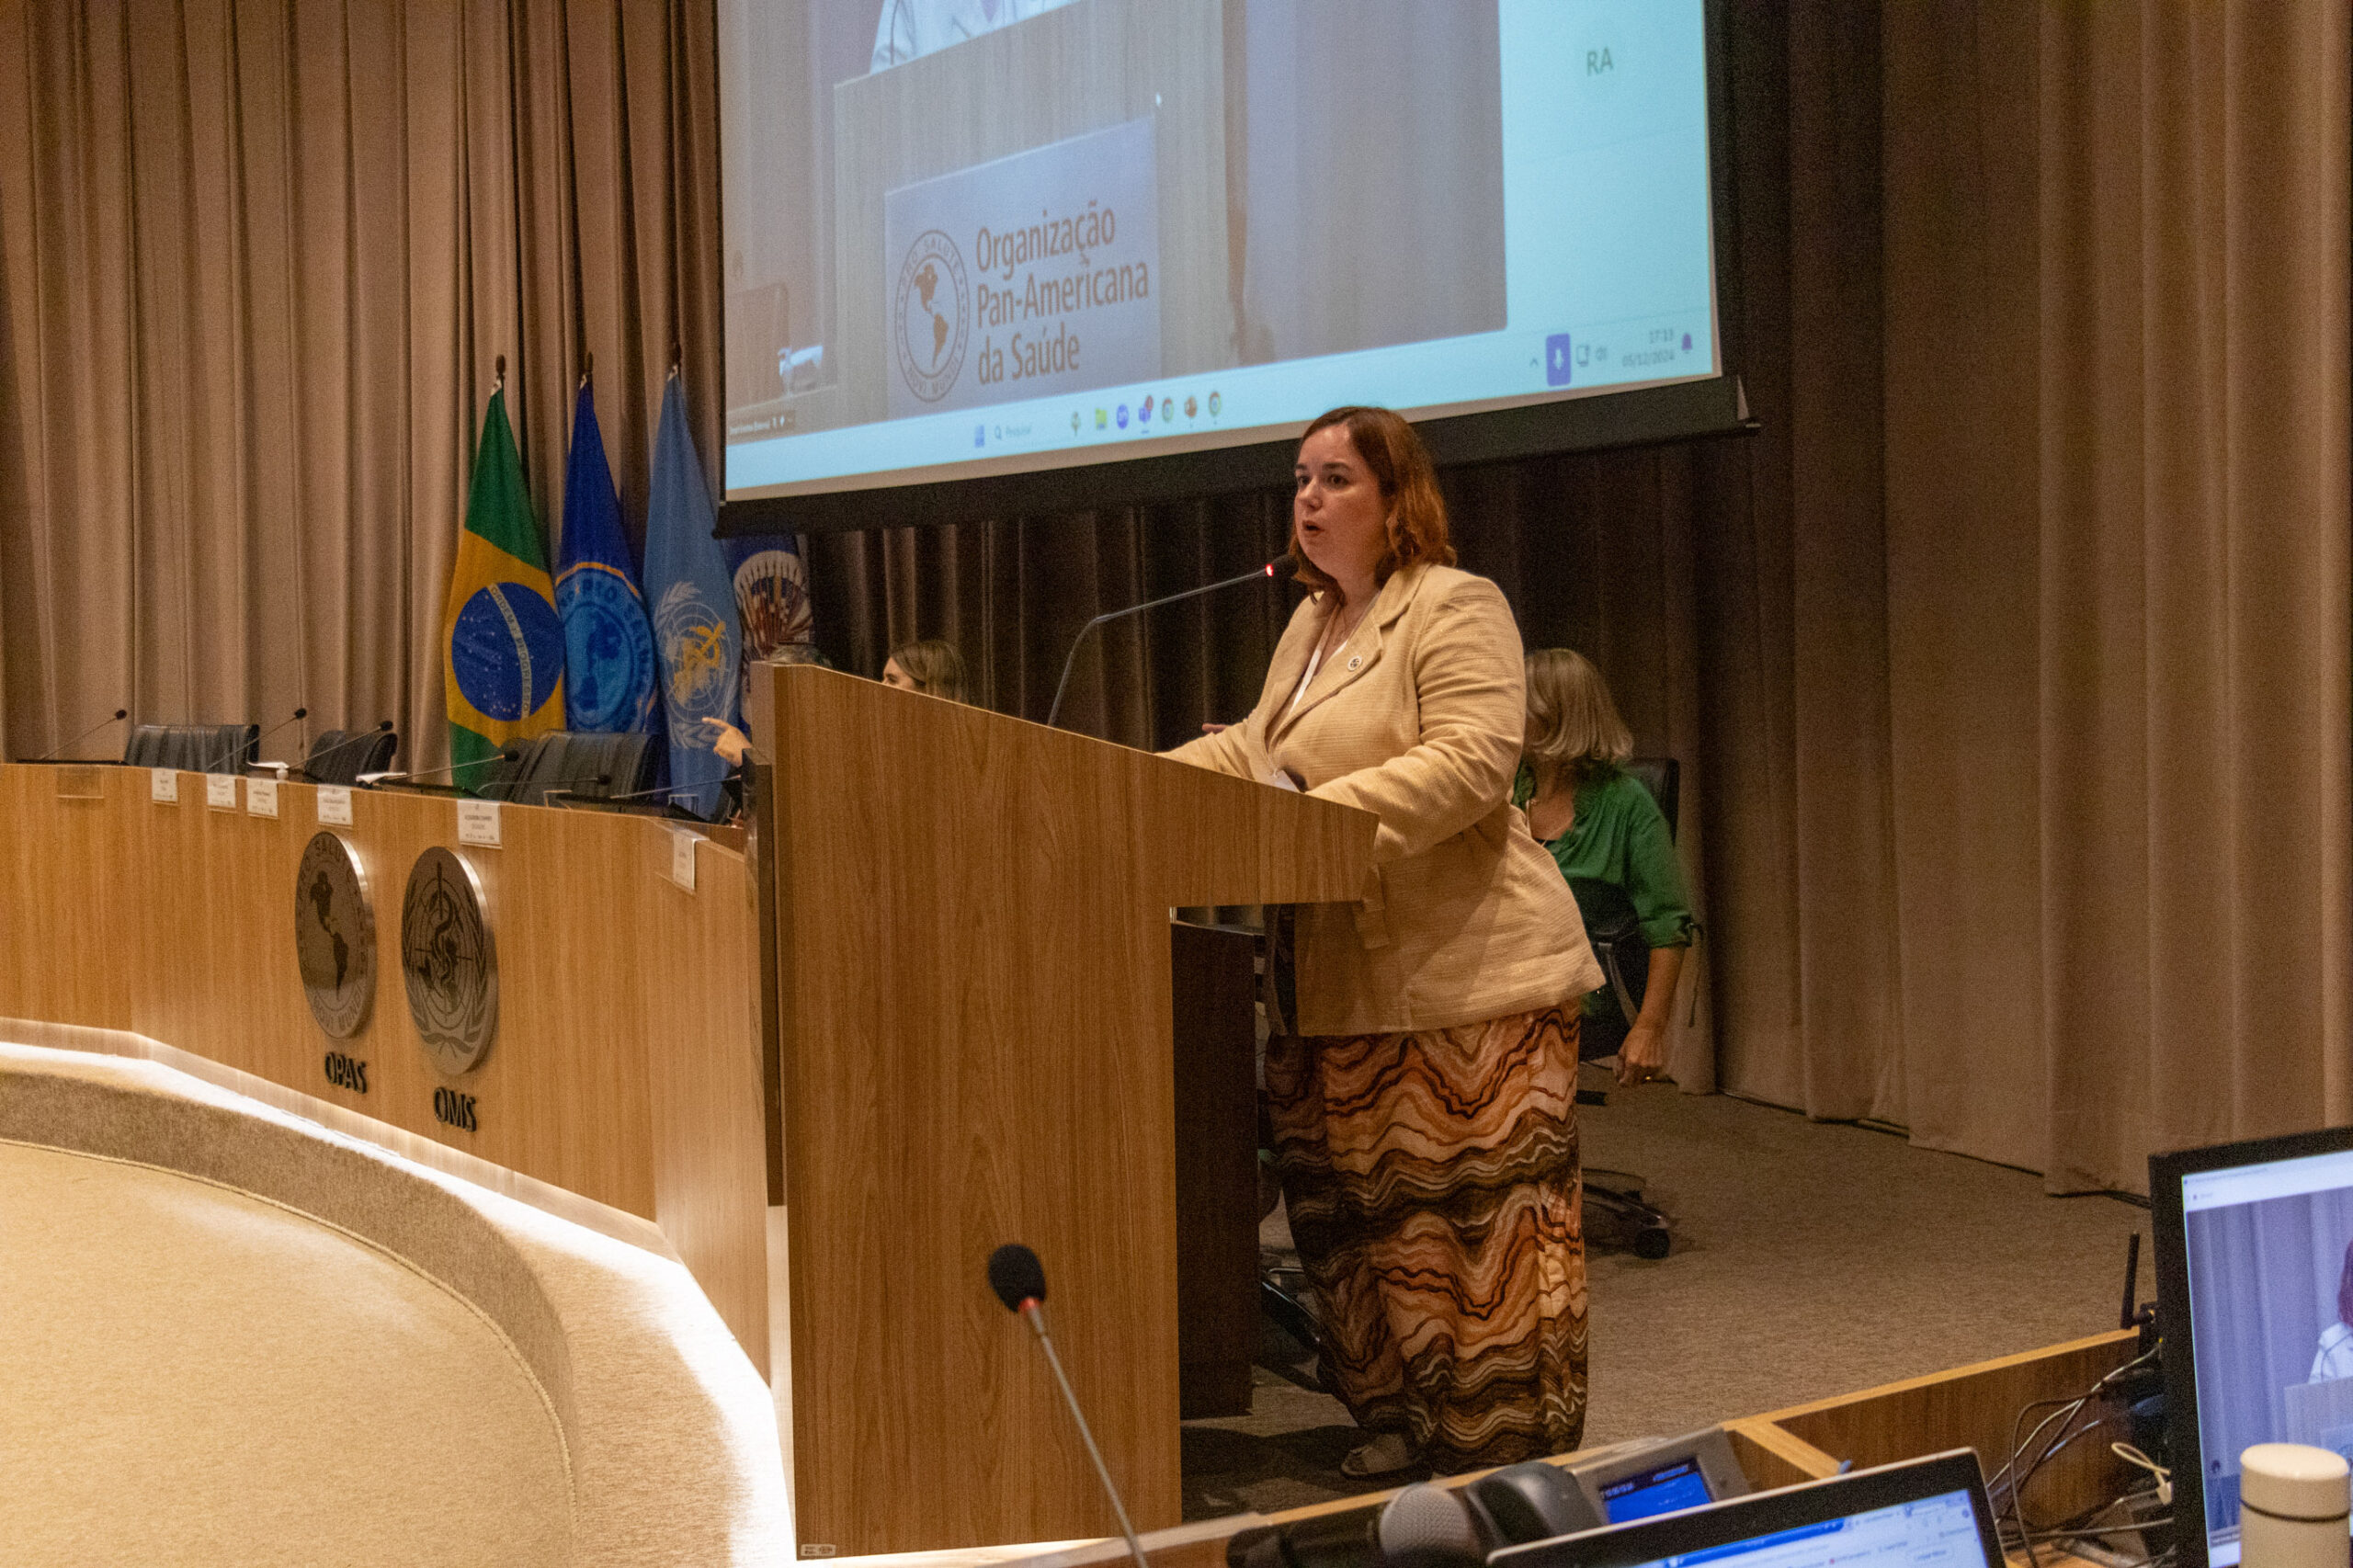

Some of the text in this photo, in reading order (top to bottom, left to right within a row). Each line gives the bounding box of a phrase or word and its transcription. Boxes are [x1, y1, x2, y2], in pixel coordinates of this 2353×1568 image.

[1586, 47, 1613, 76] RA
[976, 199, 1115, 280] Organização
[978, 261, 1149, 329] Pan-Americana
[978, 322, 1080, 385] da Saúde
[324, 1051, 367, 1094] OPAS
[433, 1086, 477, 1132] OMS
